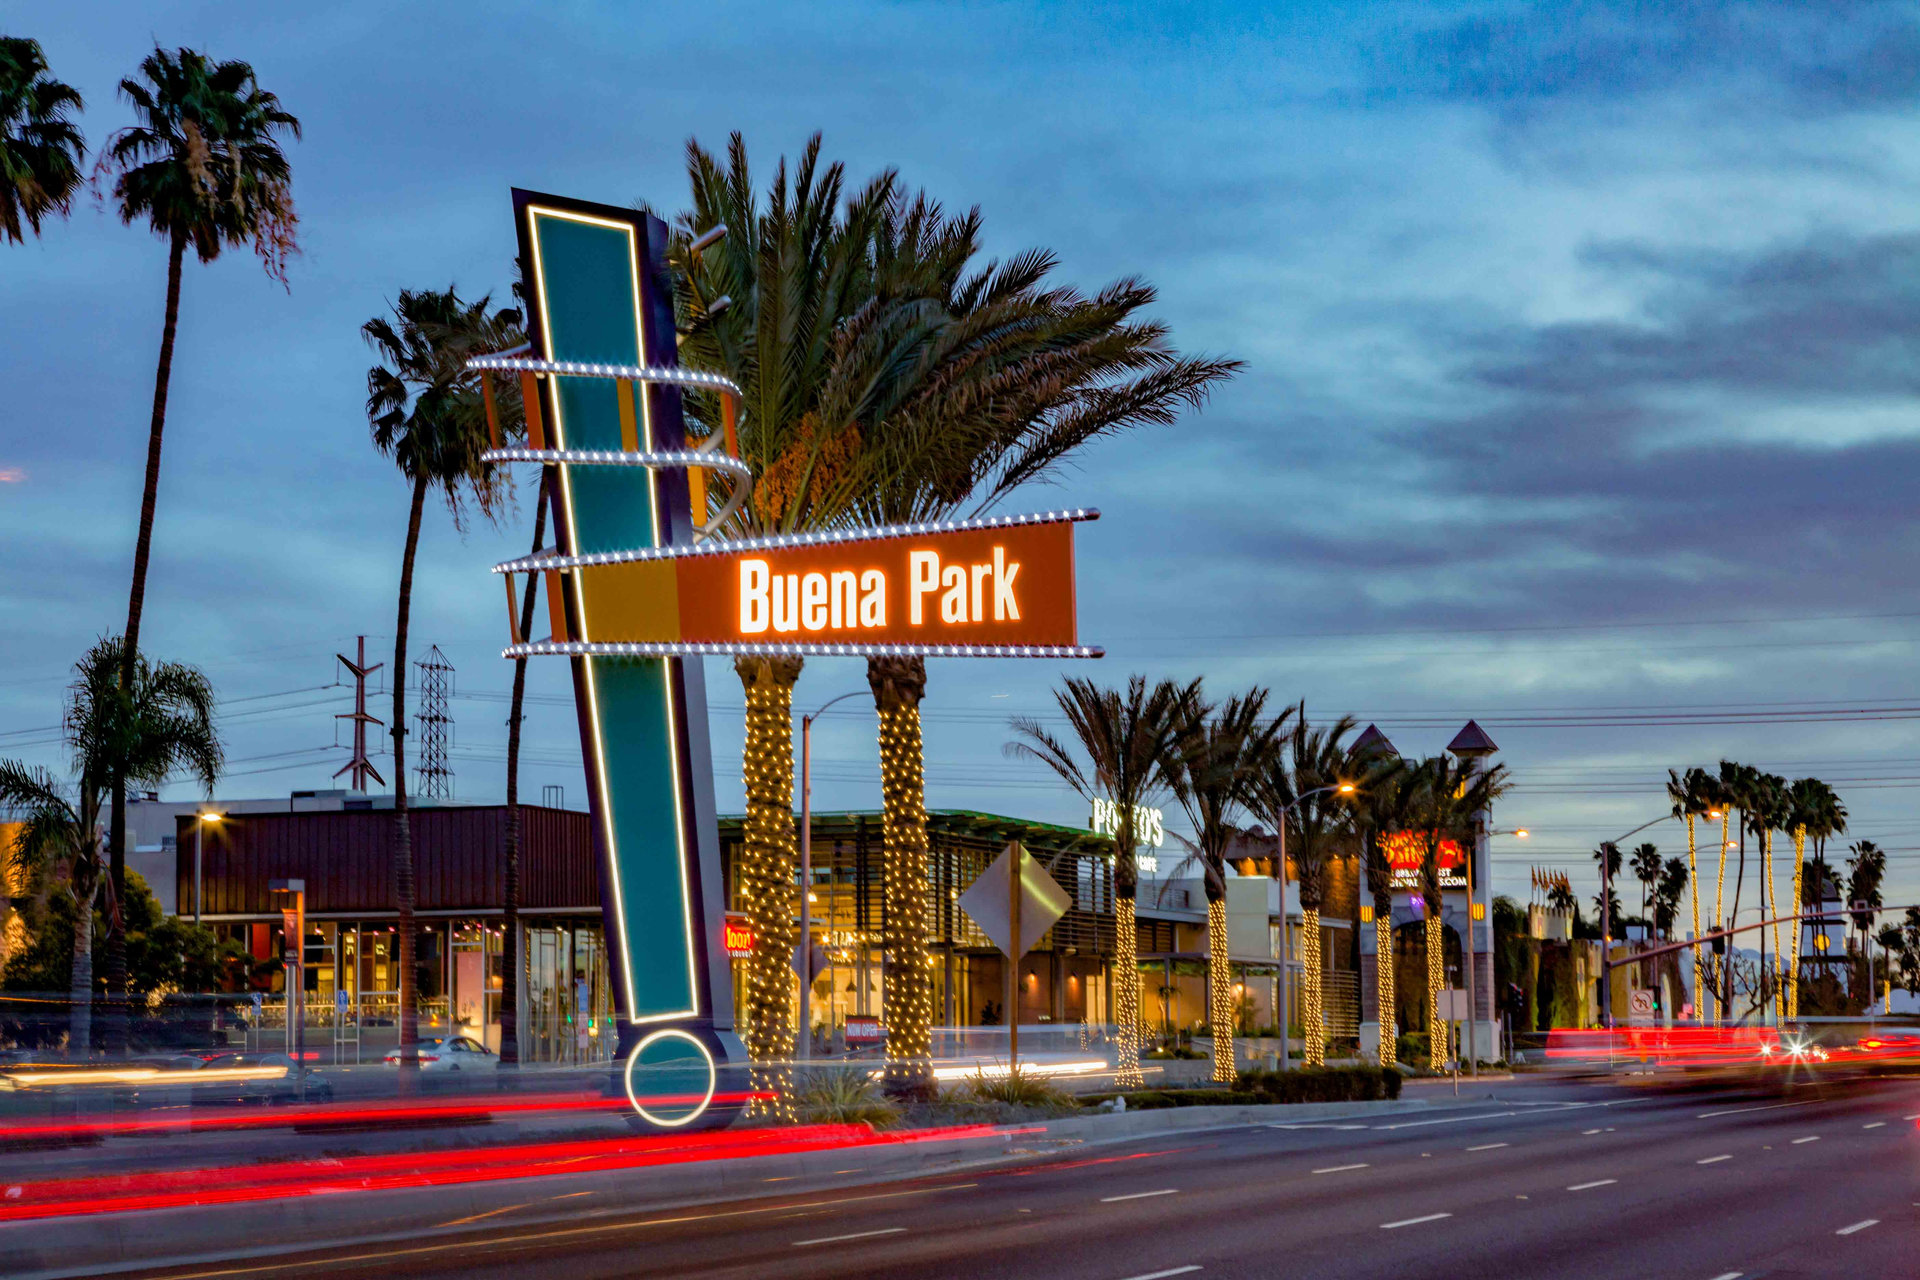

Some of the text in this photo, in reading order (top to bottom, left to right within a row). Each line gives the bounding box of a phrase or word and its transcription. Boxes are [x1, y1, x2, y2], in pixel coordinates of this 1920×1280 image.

[739, 546, 1020, 633] Buena Park
[1093, 798, 1163, 847] POTO'S
[847, 1023, 878, 1037] NOW OPEN
